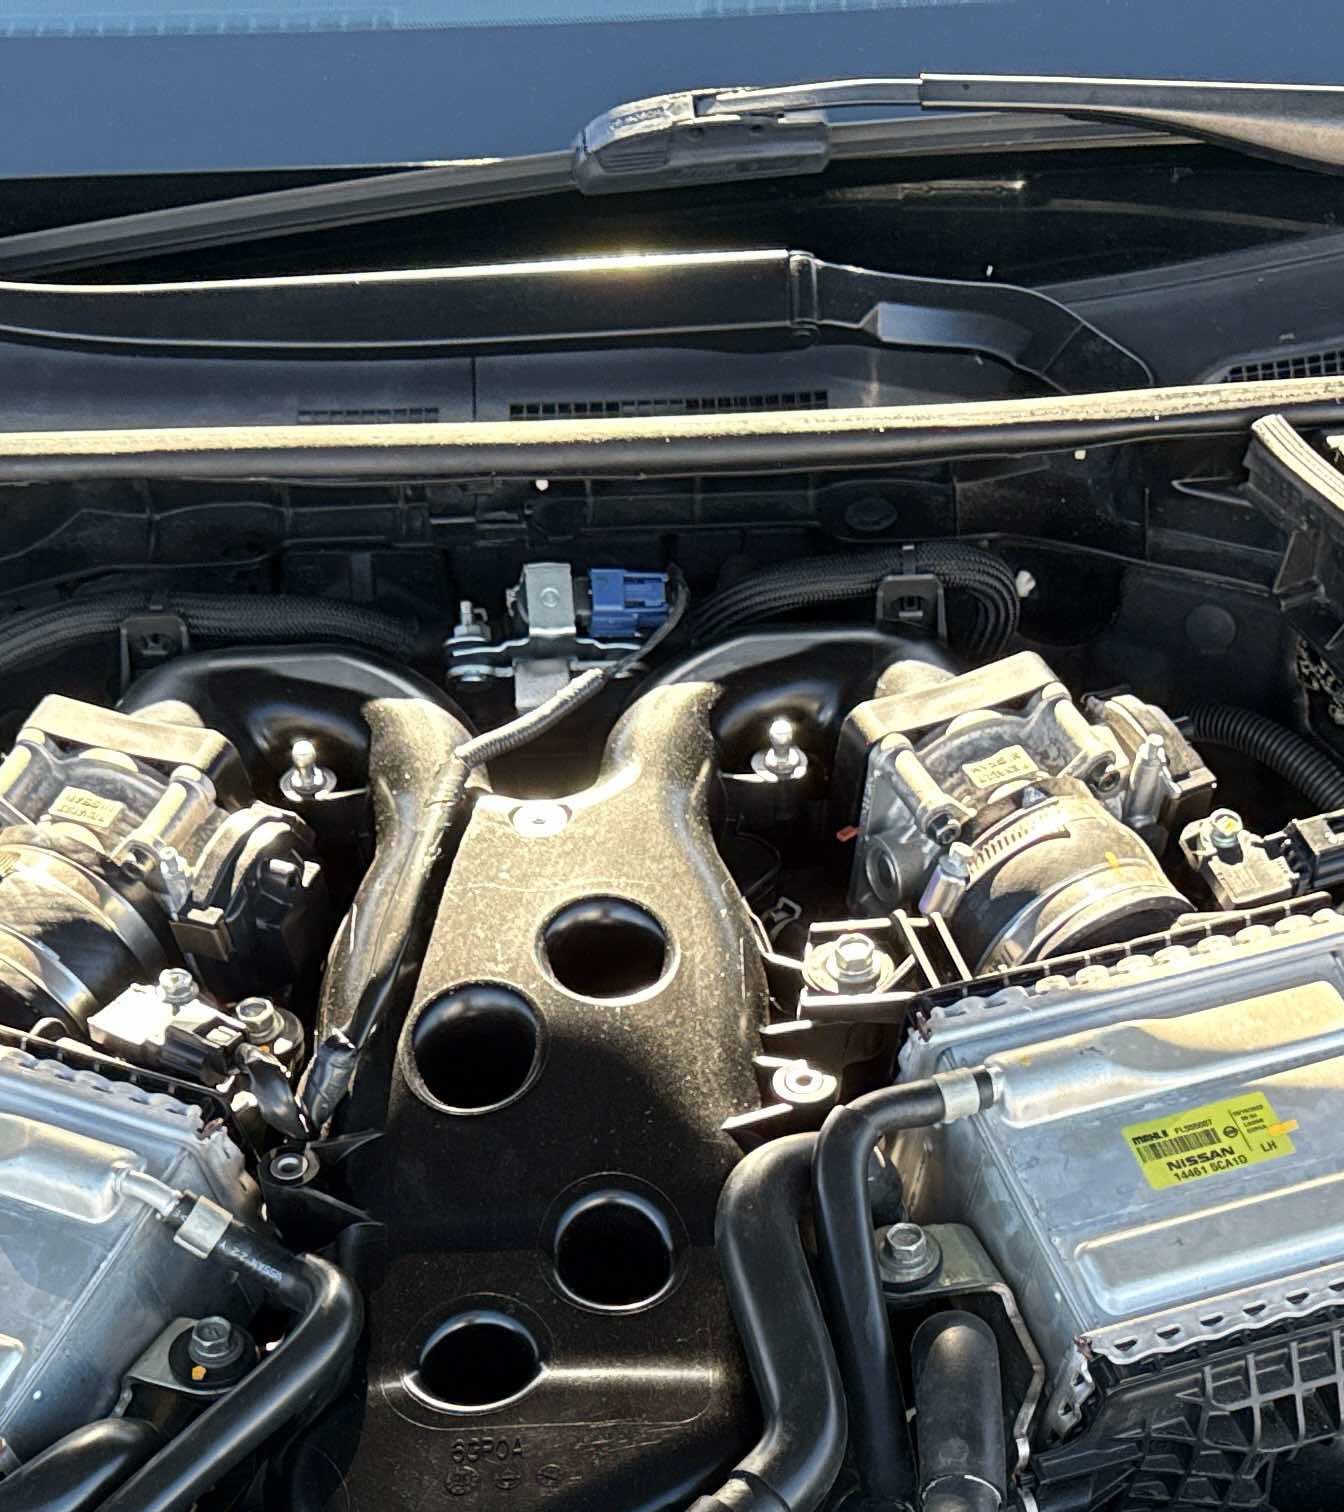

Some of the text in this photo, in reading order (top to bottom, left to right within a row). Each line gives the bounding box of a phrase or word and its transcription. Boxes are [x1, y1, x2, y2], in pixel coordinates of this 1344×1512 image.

[1260, 1140, 1278, 1152] LH
[1166, 1146, 1235, 1171] NISSAN
[1174, 1164, 1208, 1181] 14461
